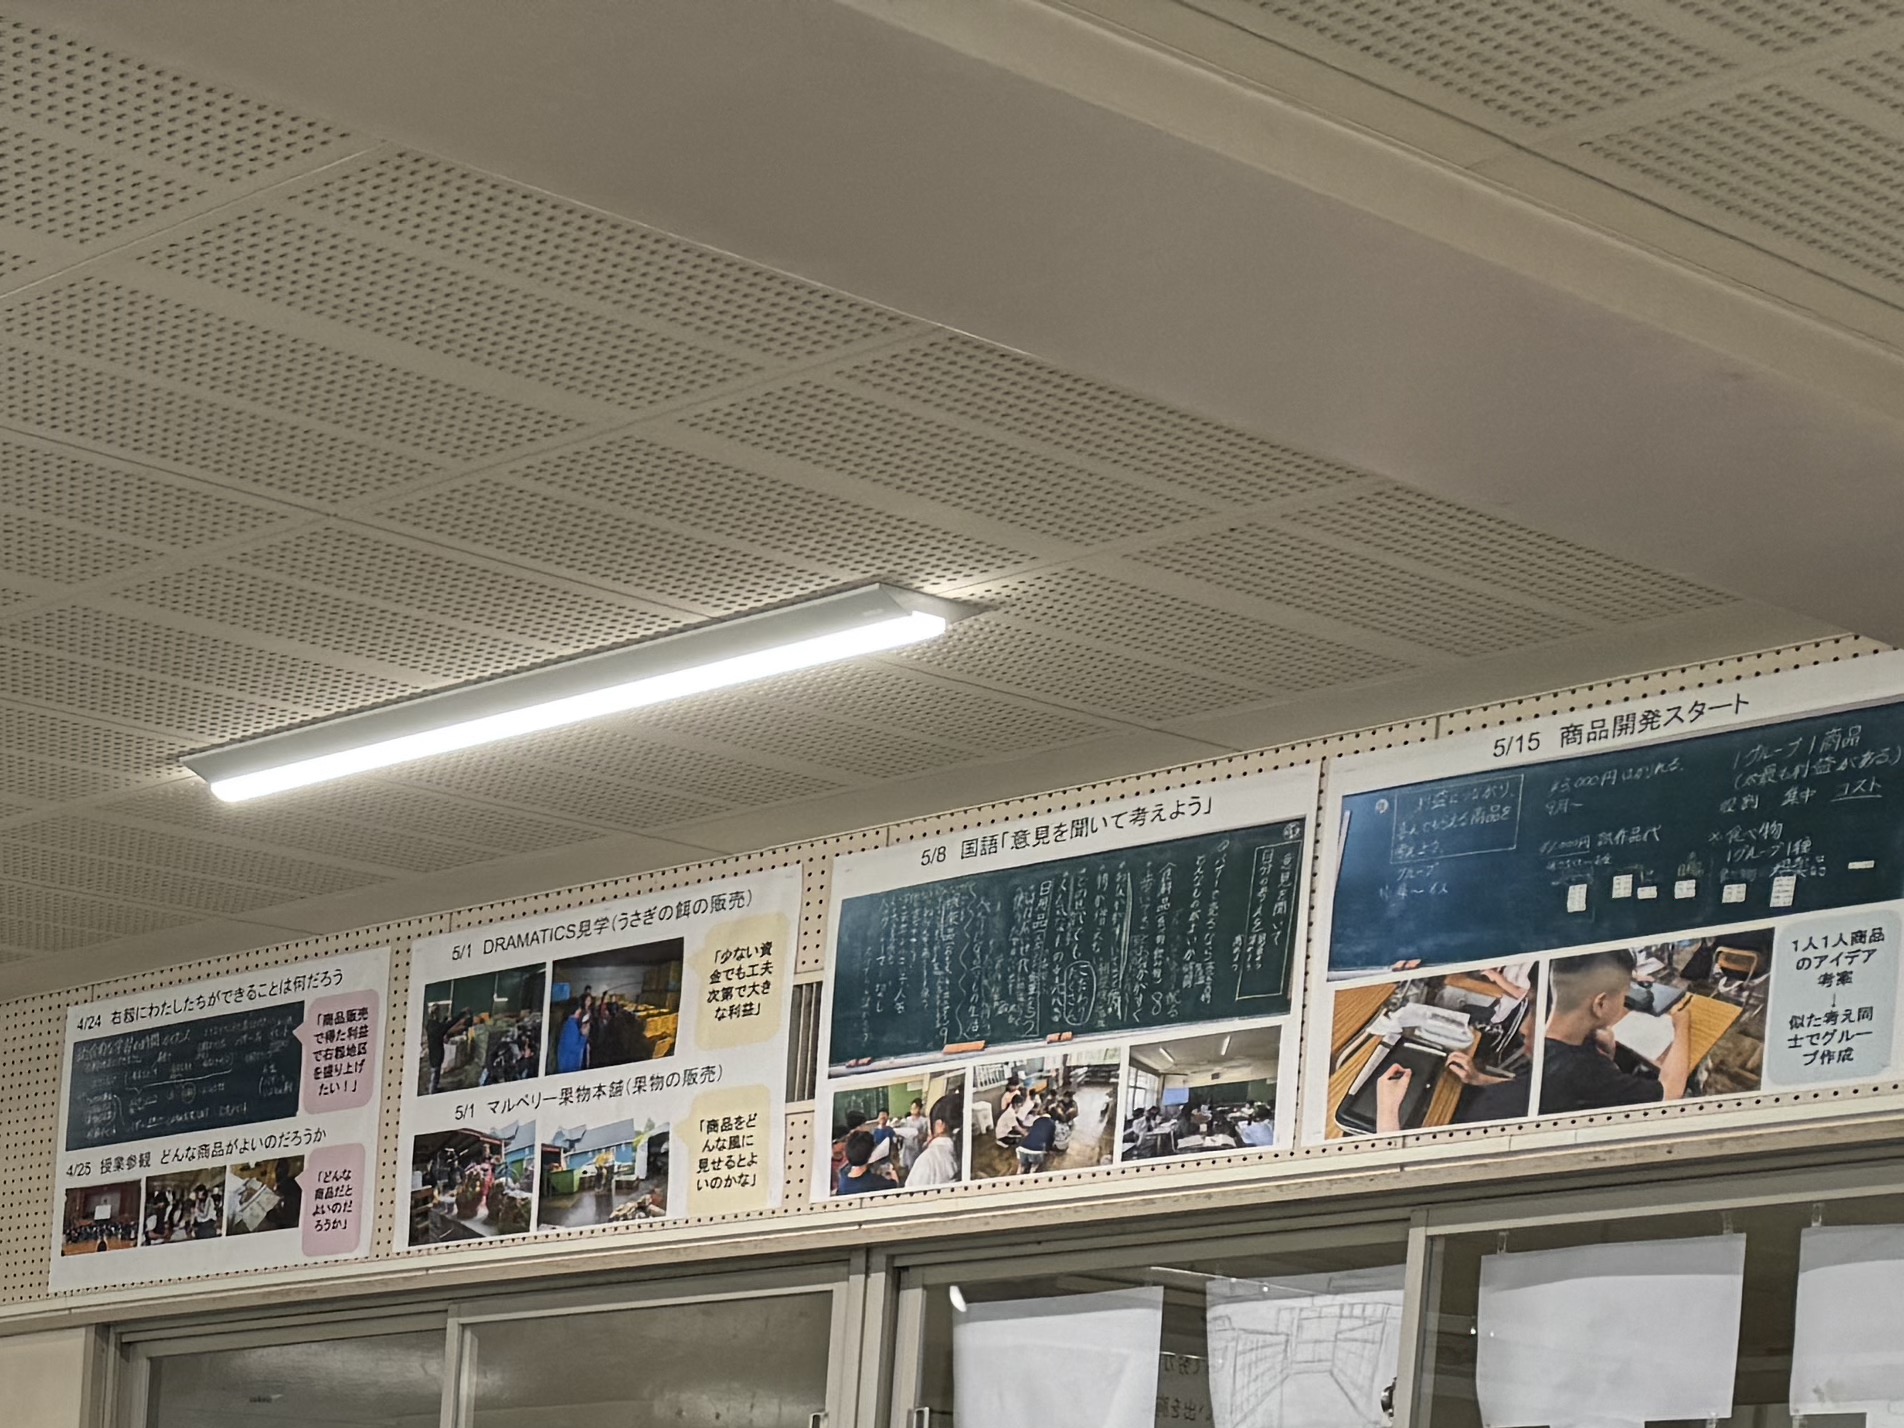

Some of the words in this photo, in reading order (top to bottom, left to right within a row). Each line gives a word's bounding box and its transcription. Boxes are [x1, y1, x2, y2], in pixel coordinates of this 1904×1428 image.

[1492, 734, 1541, 758] 5/15
[1560, 693, 1751, 749] 商品開発スタート
[921, 847, 948, 867] 5/8
[960, 797, 1212, 860] 国語「意見を聞いて考えよう」
[452, 943, 472, 961] 5/1
[714, 941, 773, 965] 「少ない資
[1796, 948, 1879, 971] のアイデア
[710, 961, 774, 985] 金でも工夫
[707, 981, 772, 1004] 次第で大き
[714, 1002, 761, 1021] な利益」
[1789, 1006, 1874, 1030] 似た考え同
[77, 1013, 101, 1031] 4/24
[1787, 1029, 1873, 1048] 士でグルー
[1803, 1048, 1854, 1066] プ作成
[455, 1103, 475, 1120] 5/1
[699, 1113, 757, 1135] 「商品をど
[66, 1162, 91, 1177] 4/25
[100, 1151, 151, 1175] 授業参観
[160, 1128, 326, 1165] どんな商品がよいのだろうか
[702, 1135, 754, 1152] んな風に
[697, 1153, 758, 1174] 見せるとよ
[315, 1183, 353, 1199] 商品だと
[697, 1173, 757, 1191] いのかな」
[312, 1200, 353, 1216] よいのだ
